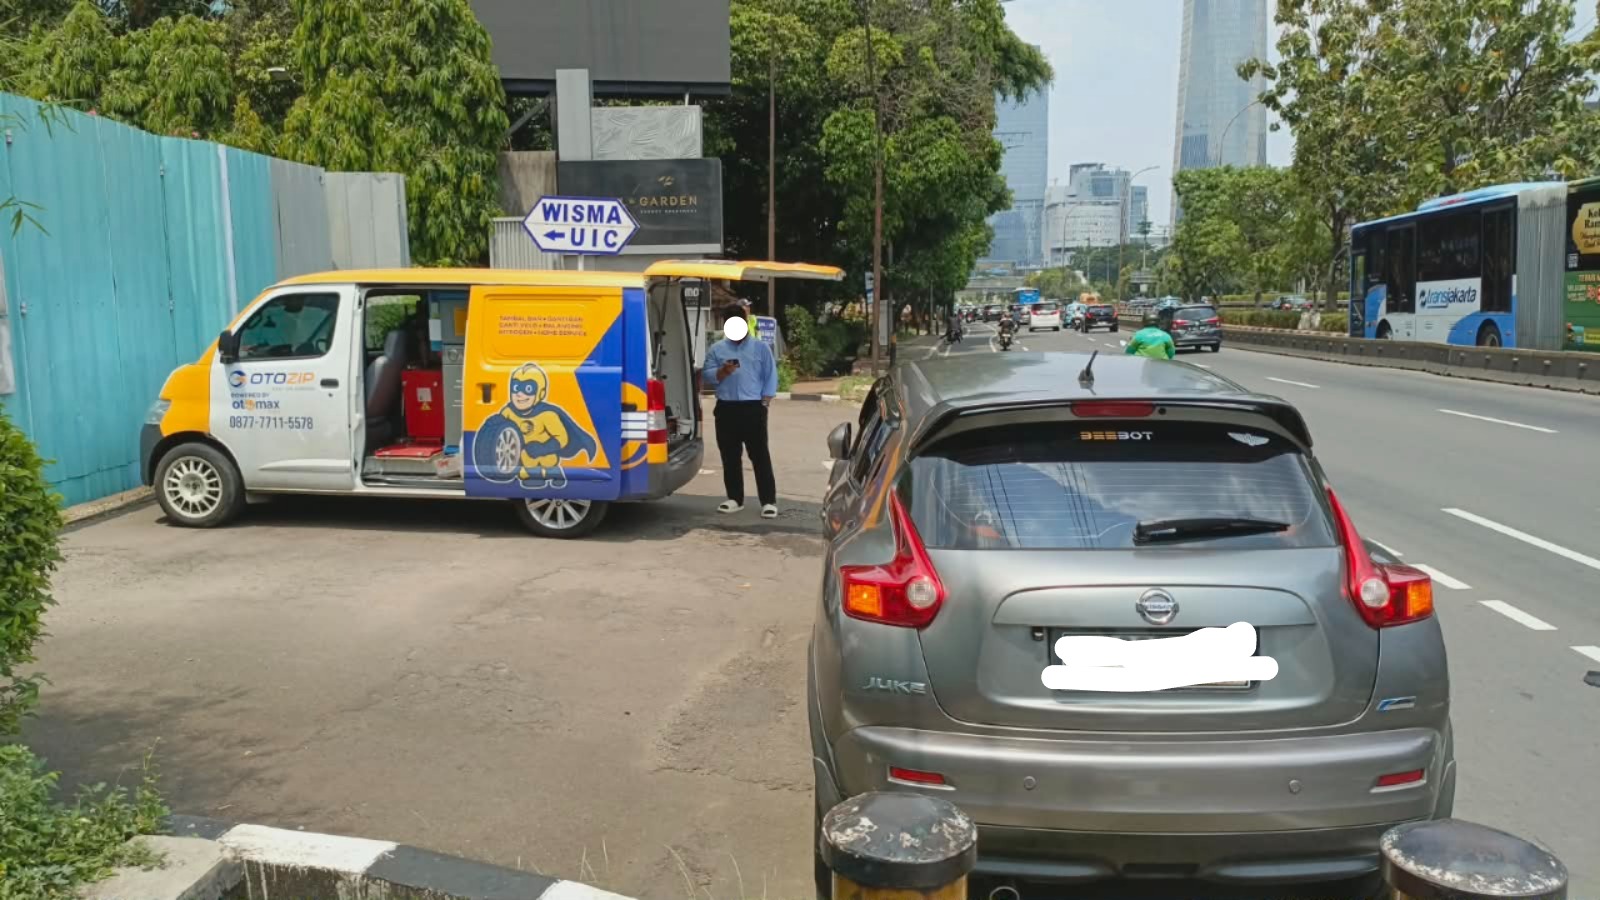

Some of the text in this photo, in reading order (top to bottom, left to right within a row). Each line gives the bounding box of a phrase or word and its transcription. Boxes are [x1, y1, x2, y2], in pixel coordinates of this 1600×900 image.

[640, 196, 697, 206] GARDEN
[542, 202, 622, 224] WISMA
[570, 228, 618, 248] UIC
[1427, 286, 1477, 304] transjakarta
[250, 372, 315, 385] OTOZIP
[229, 415, 313, 429] 0877-7711-5578
[1080, 431, 1153, 440] BEEBOT
[862, 677, 926, 694] JUKE
